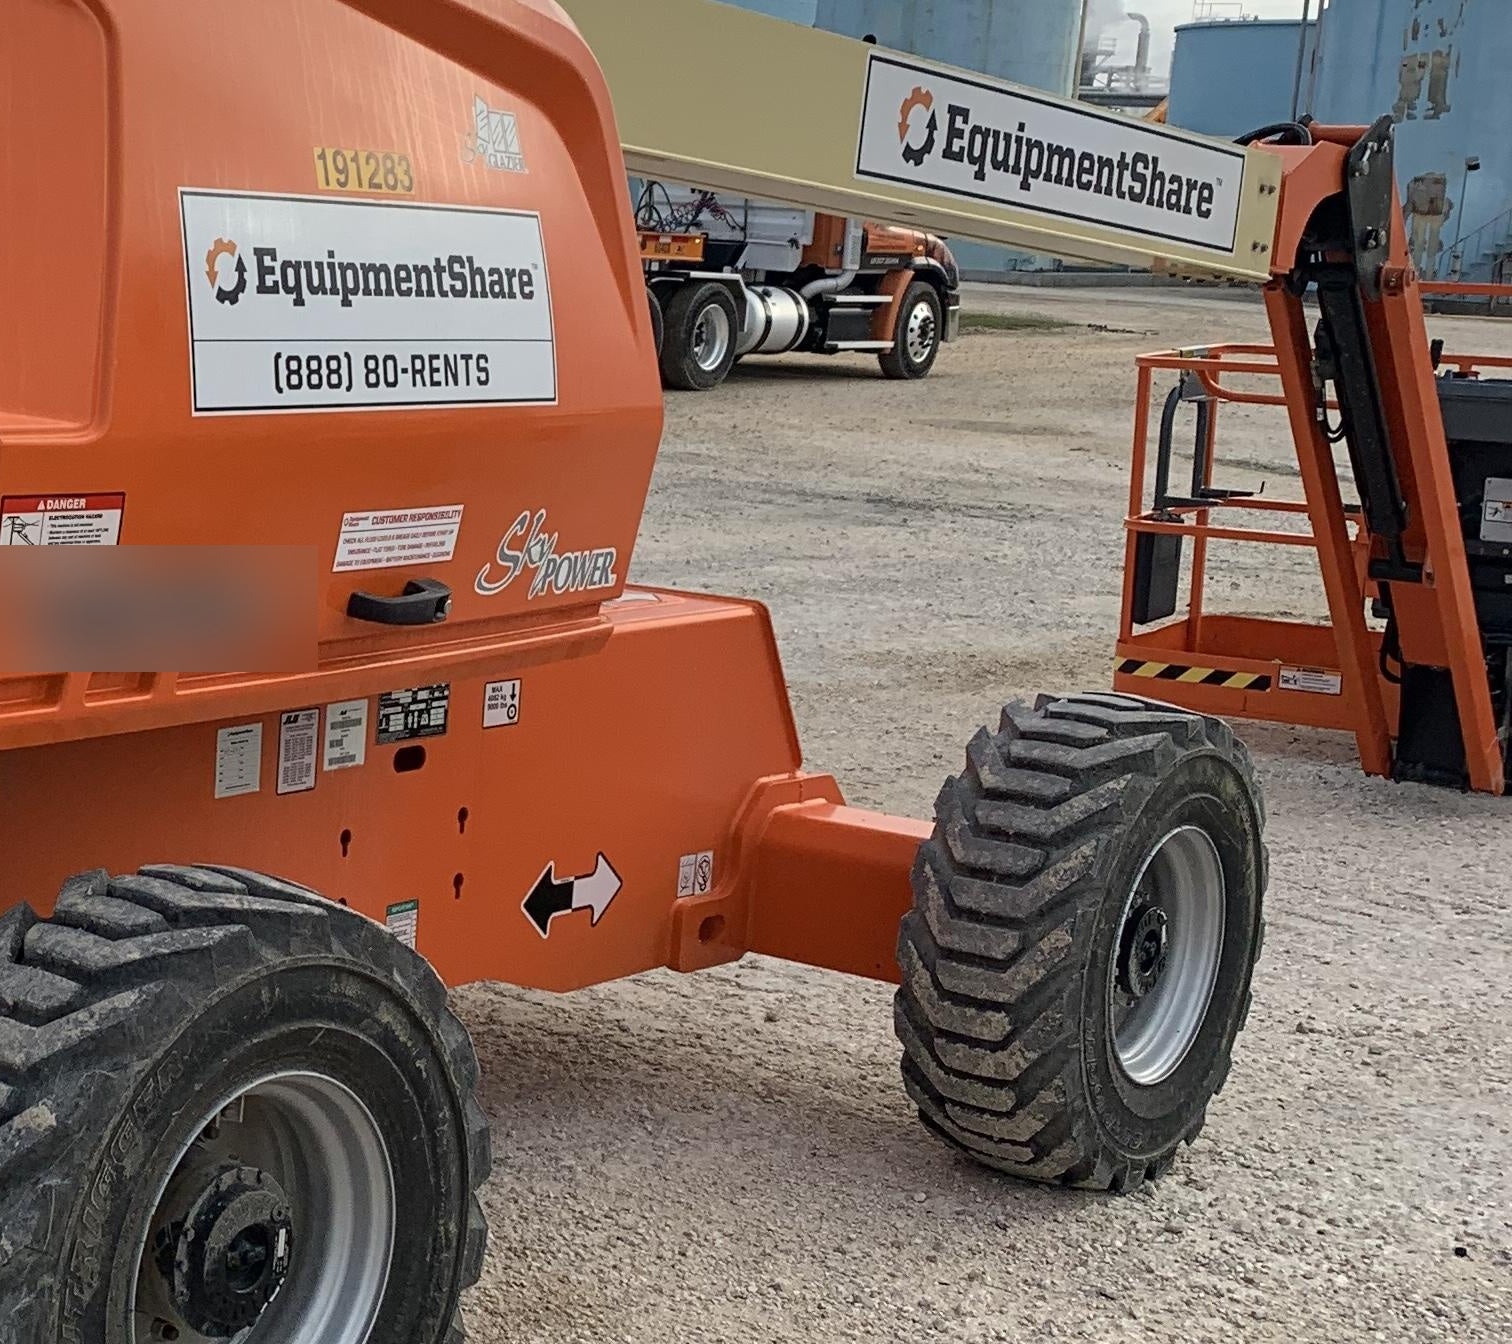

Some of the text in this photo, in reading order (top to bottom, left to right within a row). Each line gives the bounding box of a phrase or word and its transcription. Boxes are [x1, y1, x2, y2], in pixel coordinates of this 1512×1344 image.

[317, 148, 413, 192] 191283
[942, 104, 1214, 220] EquipmentShare
[254, 248, 534, 306] EquipmentShare
[274, 352, 489, 393] (888) 80-RENTS
[46, 498, 86, 509] DANGER
[372, 514, 408, 525] CUSTOMER
[409, 510, 461, 522] RESPONSIBILITY
[475, 508, 557, 599] Sky
[538, 548, 616, 594] POWER
